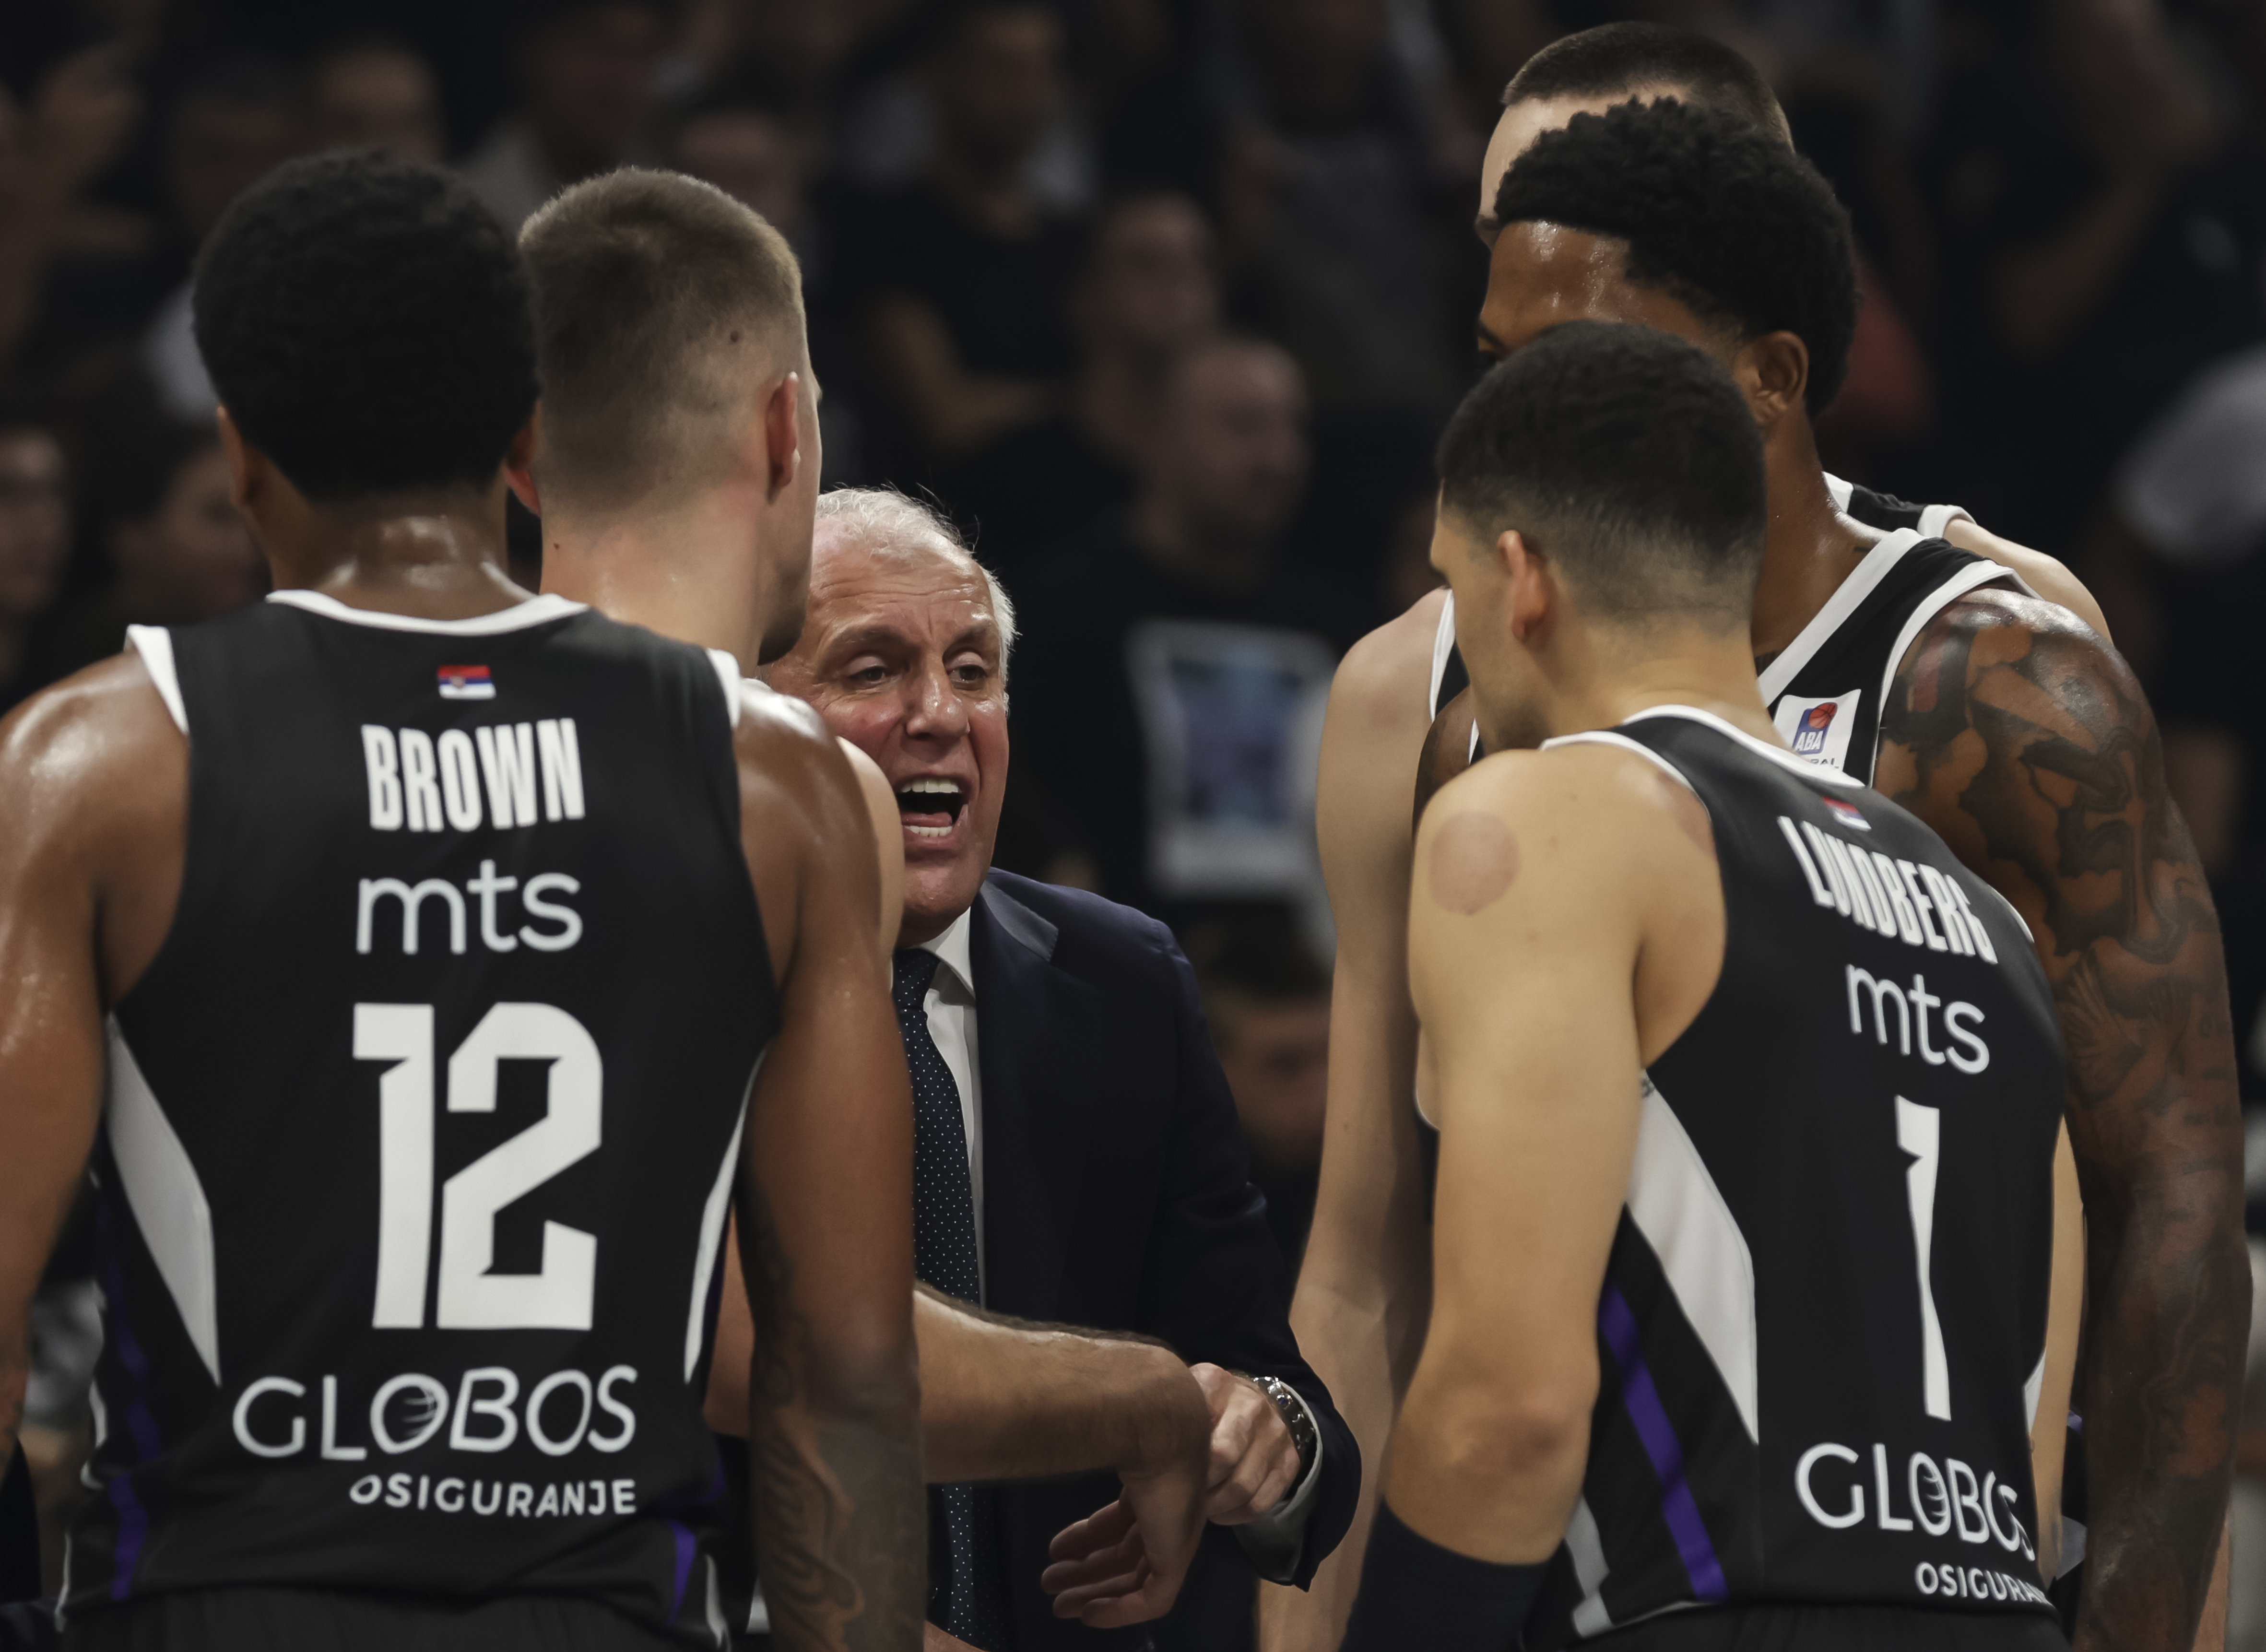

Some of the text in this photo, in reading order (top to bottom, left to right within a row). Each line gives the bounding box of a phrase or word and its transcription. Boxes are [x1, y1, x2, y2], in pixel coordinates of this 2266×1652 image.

[361, 718, 586, 832] BROWN
[1794, 730, 1824, 751] ABA
[356, 859, 583, 955] mts
[1778, 815, 1999, 964] LUNDBERG
[1846, 964, 1990, 1074] mts
[353, 1002, 603, 1331] 12
[1895, 1095, 1951, 1421] 1
[233, 1365, 638, 1461] GLOBOS
[349, 1472, 637, 1518] OSIGURANJE
[1915, 1560, 2055, 1608] OSIGURA
